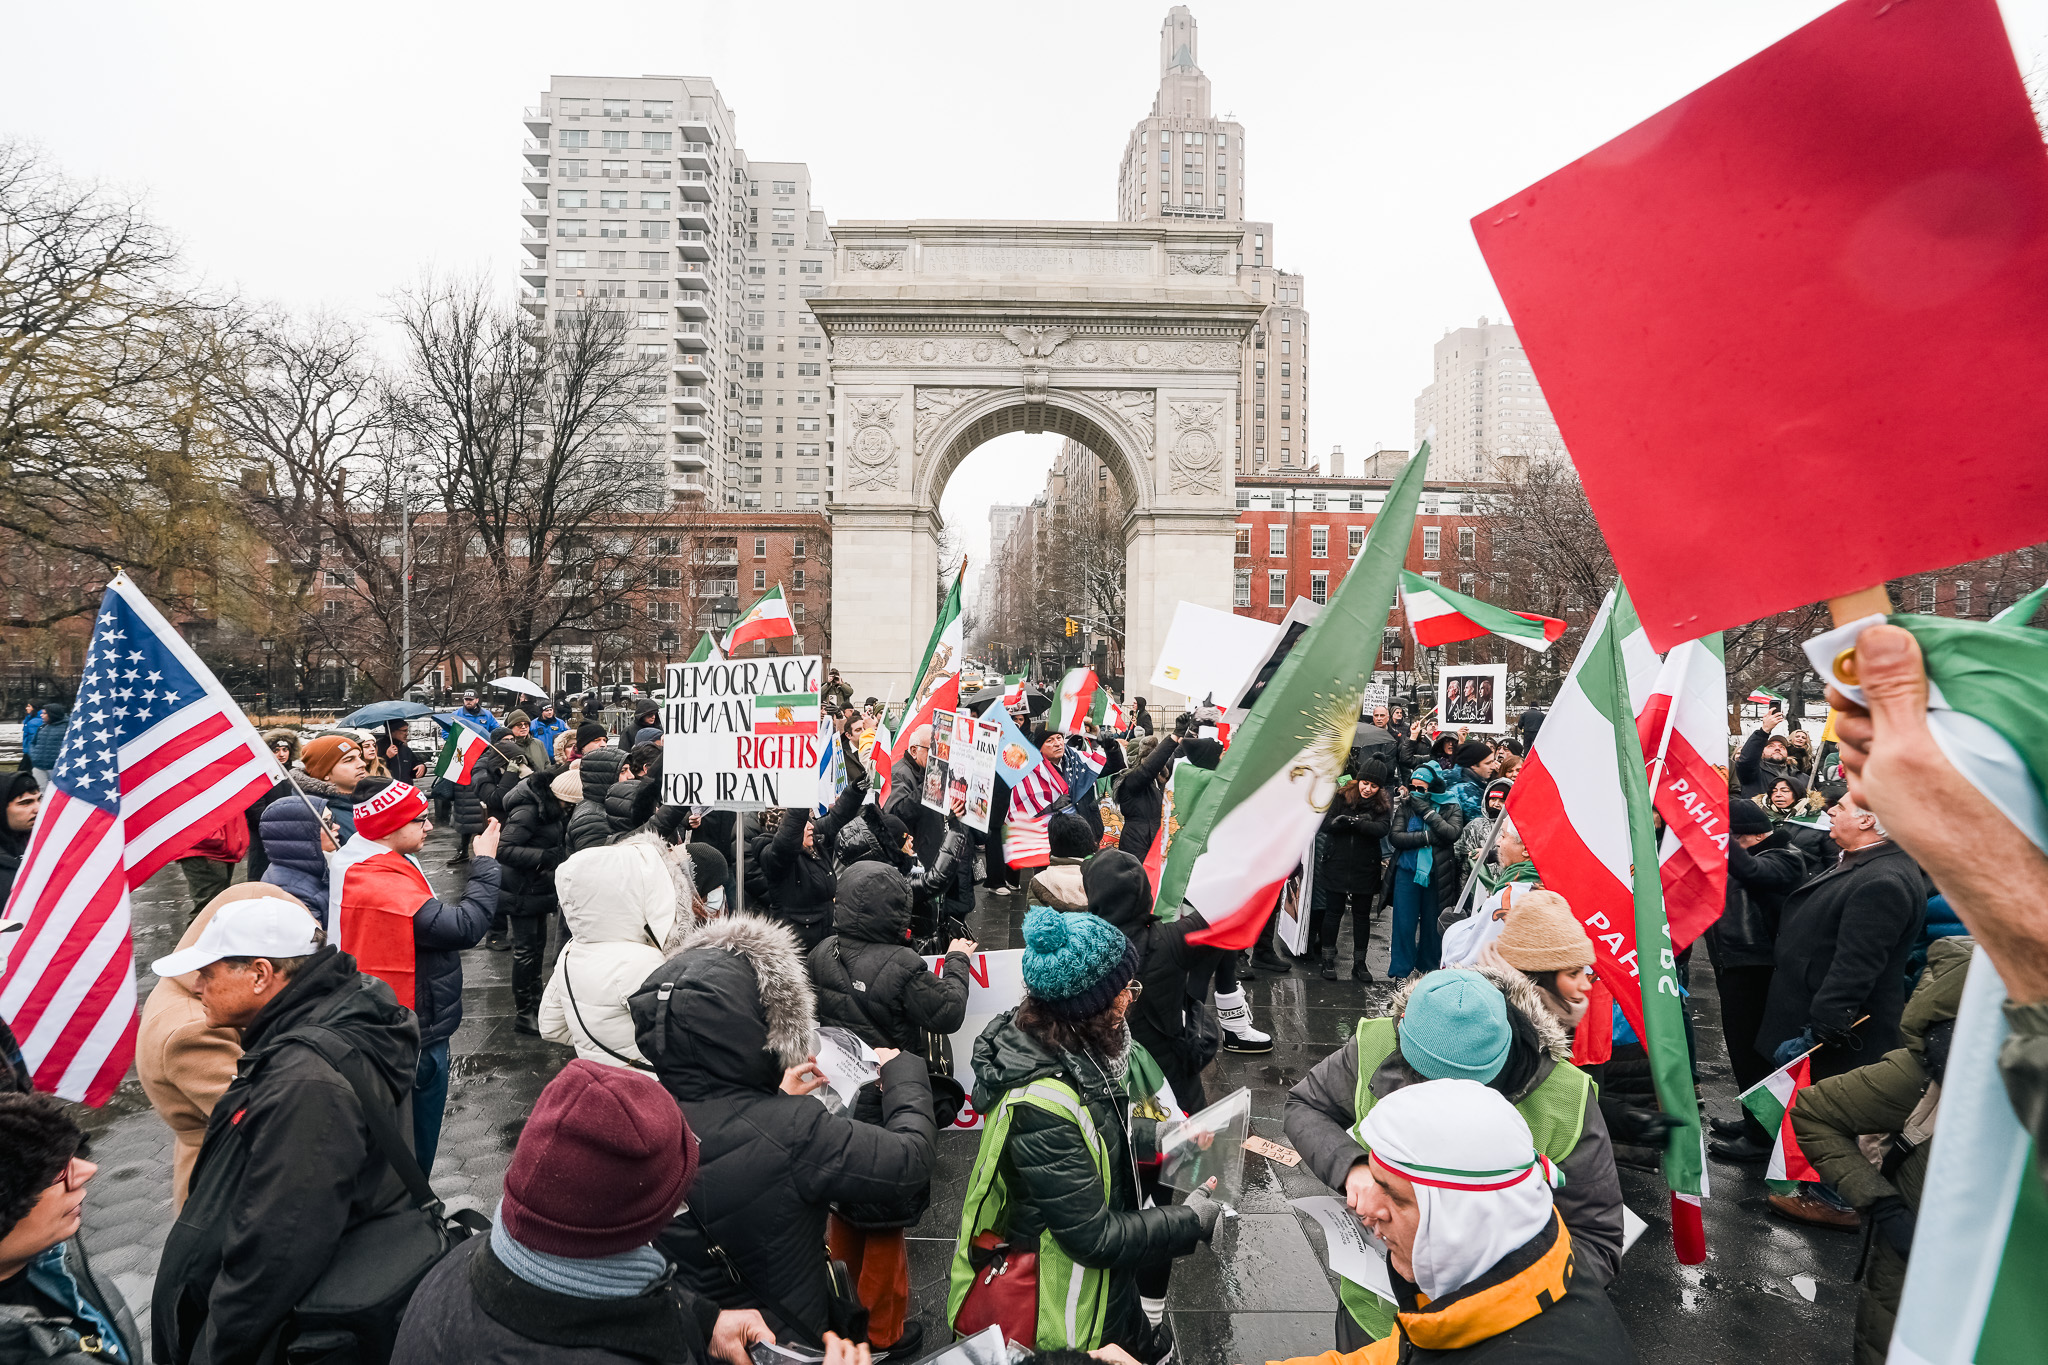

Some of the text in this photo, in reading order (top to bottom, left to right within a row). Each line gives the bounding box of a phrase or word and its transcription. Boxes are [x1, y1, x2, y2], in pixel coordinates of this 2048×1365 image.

[962, 248, 987, 256] RAISE
[1102, 250, 1119, 258] THE
[1082, 265, 1144, 273] WASHINGTON
[1113, 258, 1144, 266] EVENT
[666, 660, 818, 699] DEMOCRACY &
[665, 699, 752, 734] HUMAN
[737, 734, 819, 769] RIGHTS
[977, 740, 997, 756] IRAN
[663, 772, 779, 806] FOR IRAN
[1669, 777, 1729, 859] PAHLA
[1584, 910, 1642, 988] PAH
[856, 1061, 870, 1075] Asadi
[1259, 1148, 1293, 1162] FREE
[1262, 1142, 1295, 1156] IRAN
